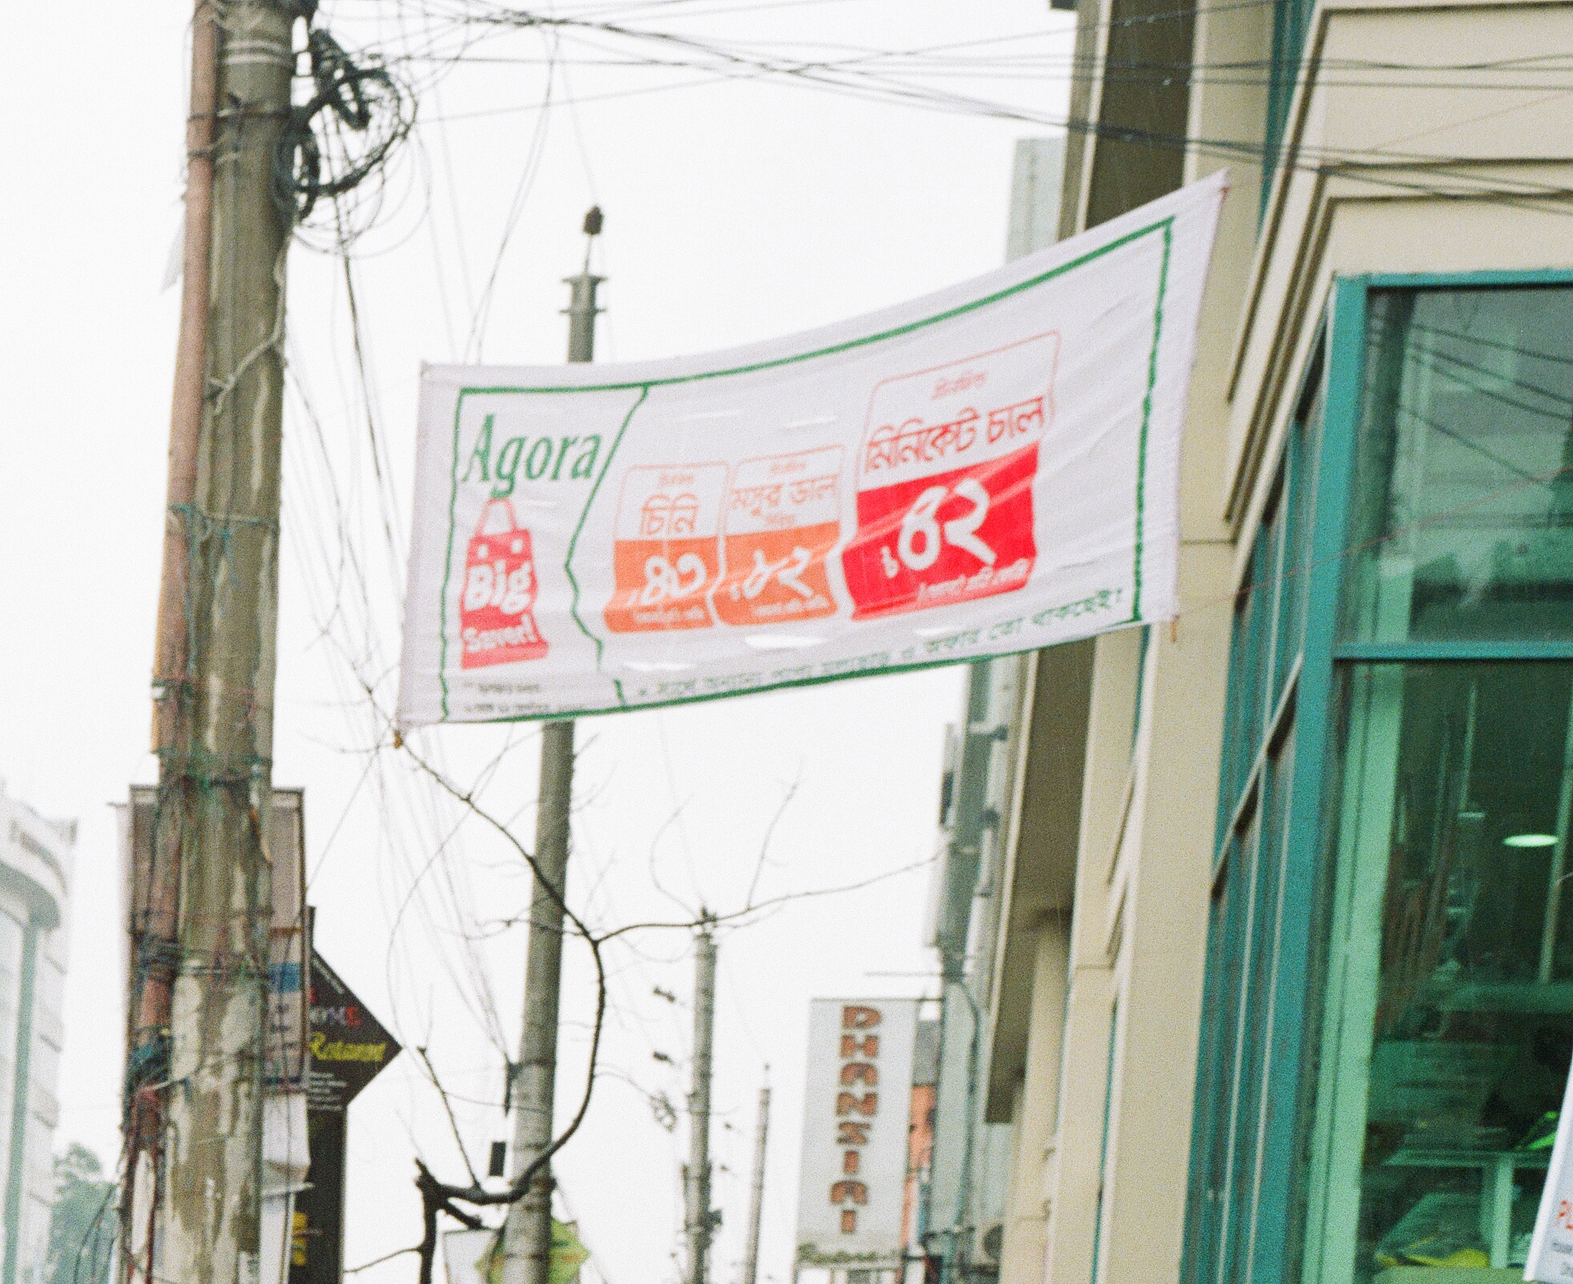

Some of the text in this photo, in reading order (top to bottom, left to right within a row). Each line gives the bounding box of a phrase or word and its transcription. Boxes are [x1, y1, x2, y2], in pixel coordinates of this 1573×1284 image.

[988, 394, 1046, 446] চাল
[460, 412, 602, 500] Agora
[639, 492, 700, 537] চিনি
[463, 559, 533, 616] Big
